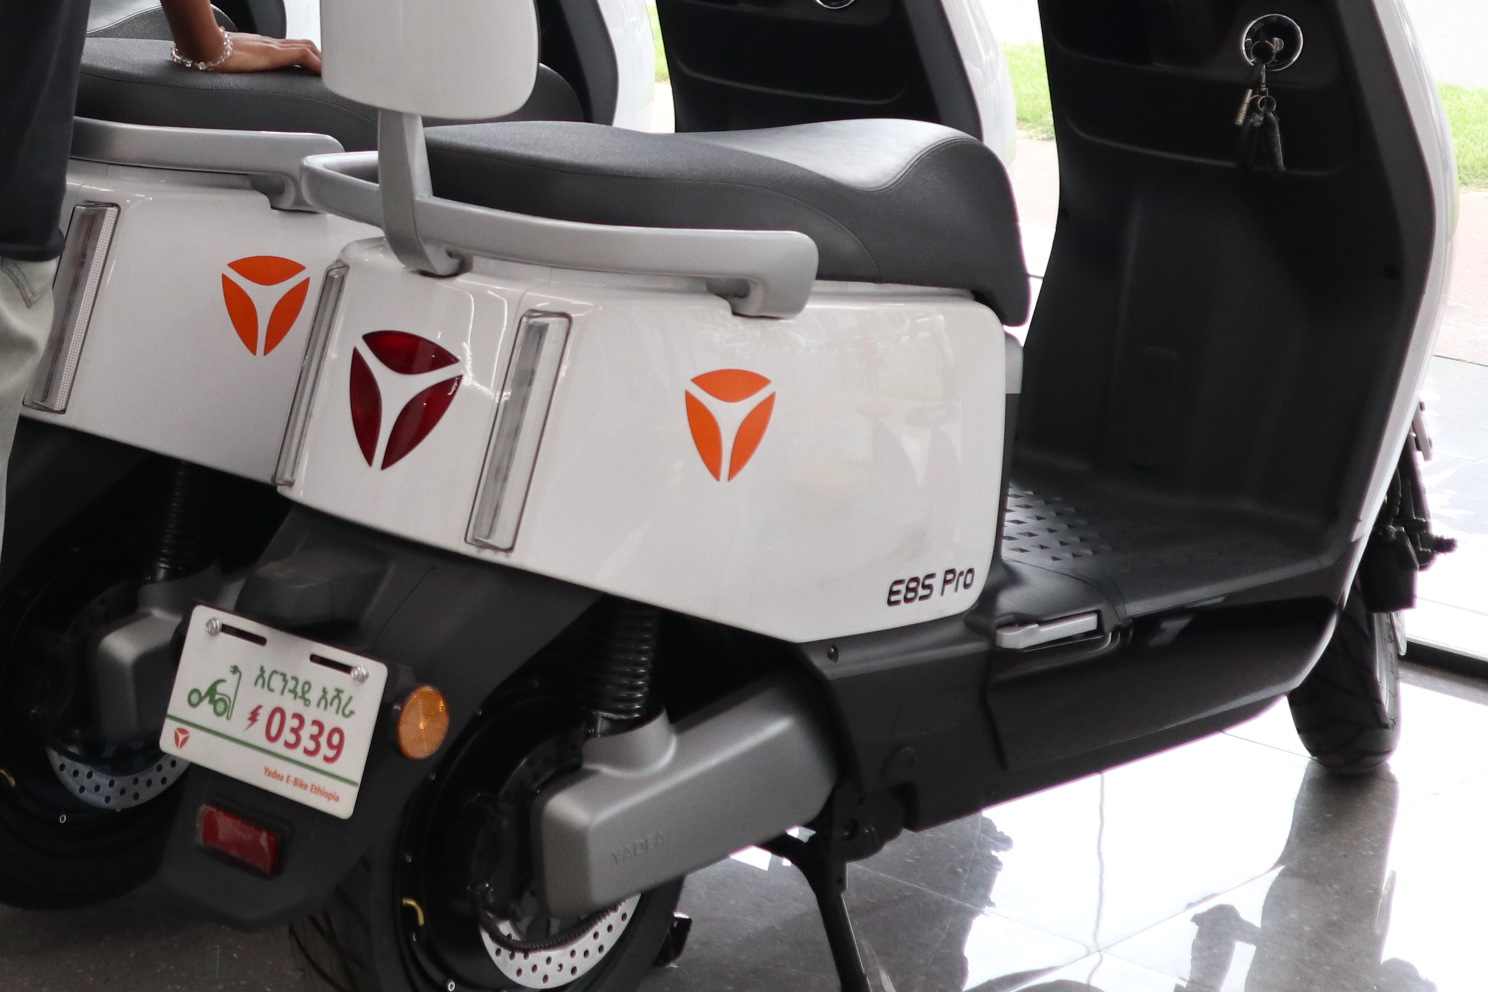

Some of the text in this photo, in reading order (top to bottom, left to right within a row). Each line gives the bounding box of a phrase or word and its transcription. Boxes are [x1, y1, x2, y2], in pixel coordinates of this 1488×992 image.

[887, 568, 975, 606] E8S Pro
[317, 687, 356, 718] አሻራ
[265, 706, 345, 764] 0339
[264, 767, 341, 803] Yadea E-Bike Ethiopia
